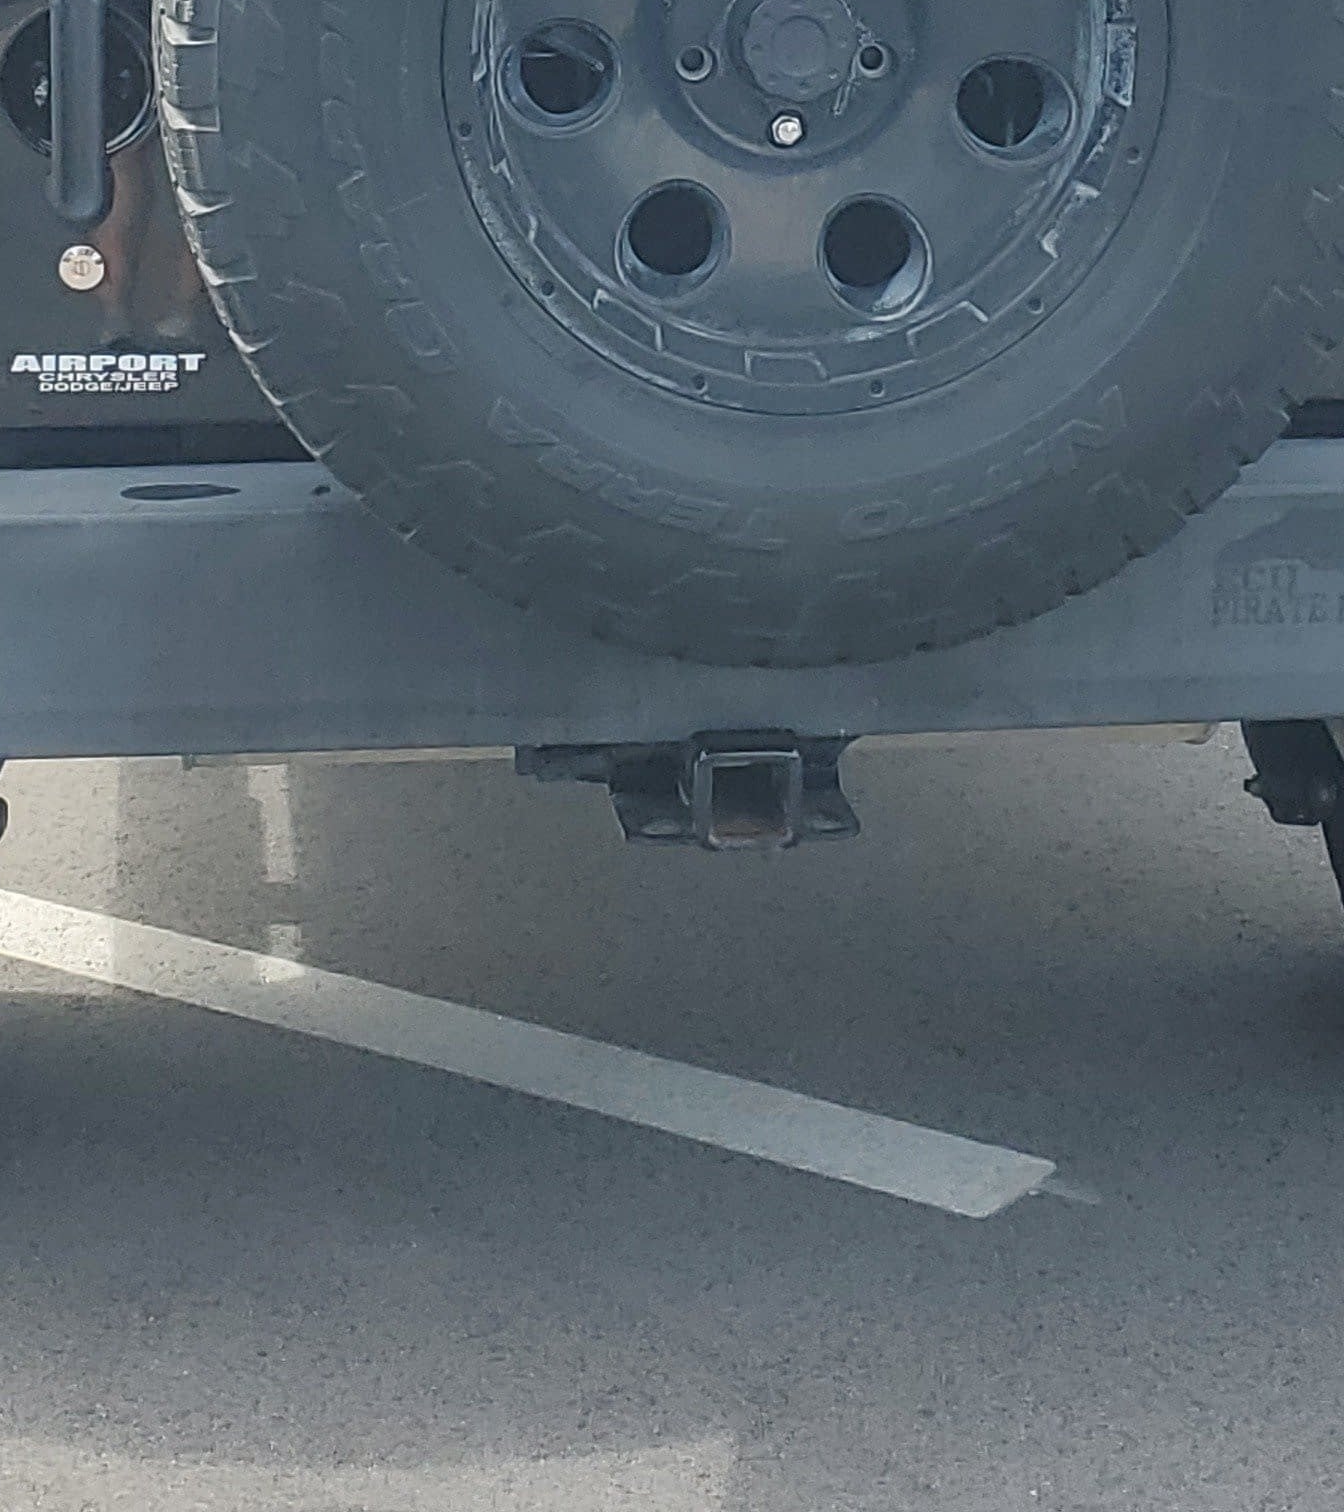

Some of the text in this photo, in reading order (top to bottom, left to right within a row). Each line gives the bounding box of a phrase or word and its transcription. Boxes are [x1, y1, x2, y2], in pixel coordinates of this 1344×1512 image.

[10, 354, 206, 372] AIRPORT
[38, 372, 177, 381] CHRYSLER
[39, 382, 179, 392] DODGE/JEEP
[1211, 592, 1328, 626] PIRATE
